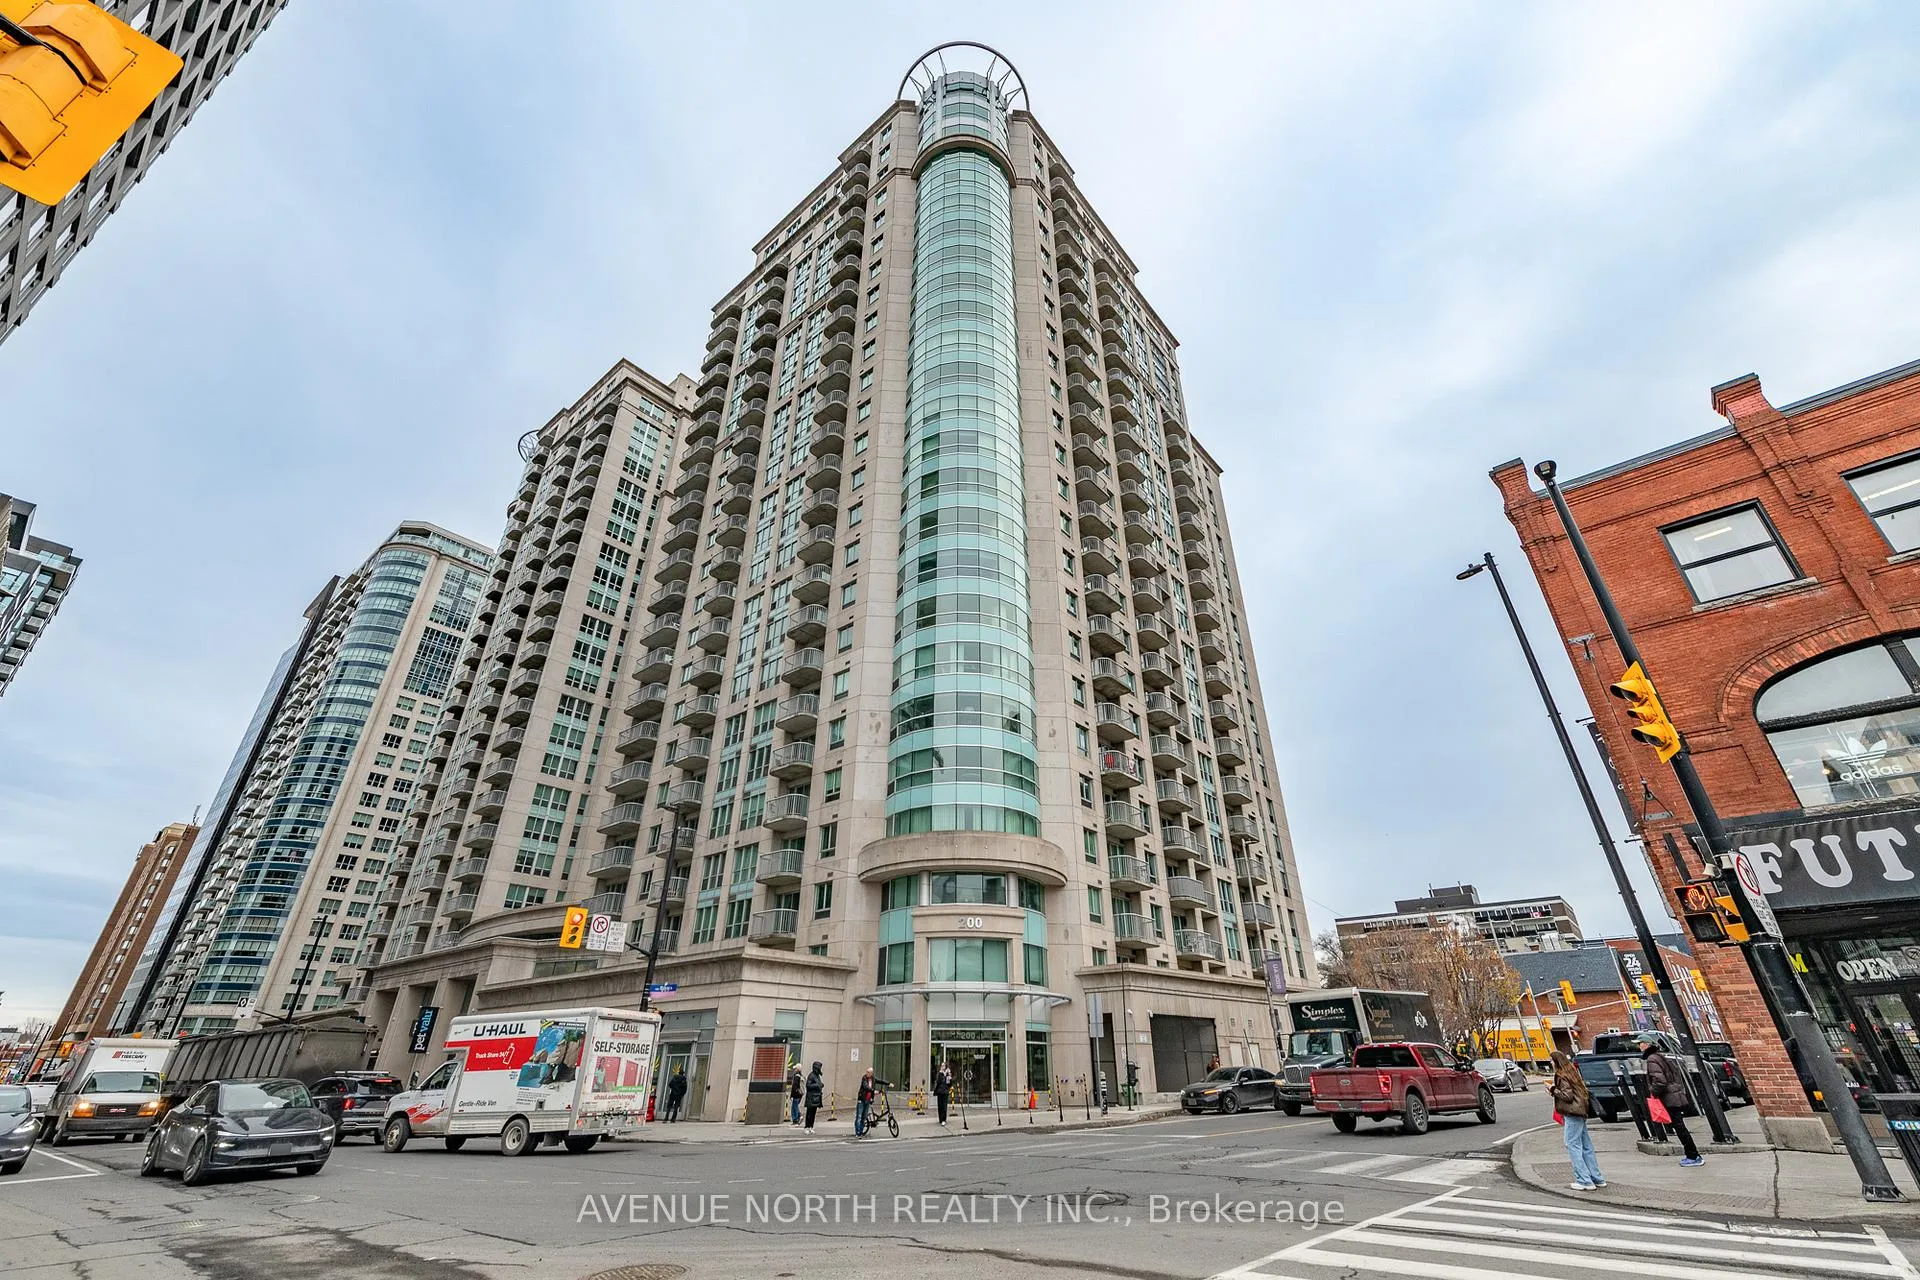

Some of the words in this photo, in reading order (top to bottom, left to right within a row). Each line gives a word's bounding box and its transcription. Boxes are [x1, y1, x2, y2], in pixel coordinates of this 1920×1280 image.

[1740, 823, 1920, 894] FUT
[1623, 957, 1641, 968] 24
[1836, 957, 1900, 981] OPEN
[1301, 1005, 1345, 1019] Simplex
[414, 1032, 426, 1051] pet
[420, 1009, 433, 1032] valu
[594, 1040, 650, 1054] SELF-STORAGE
